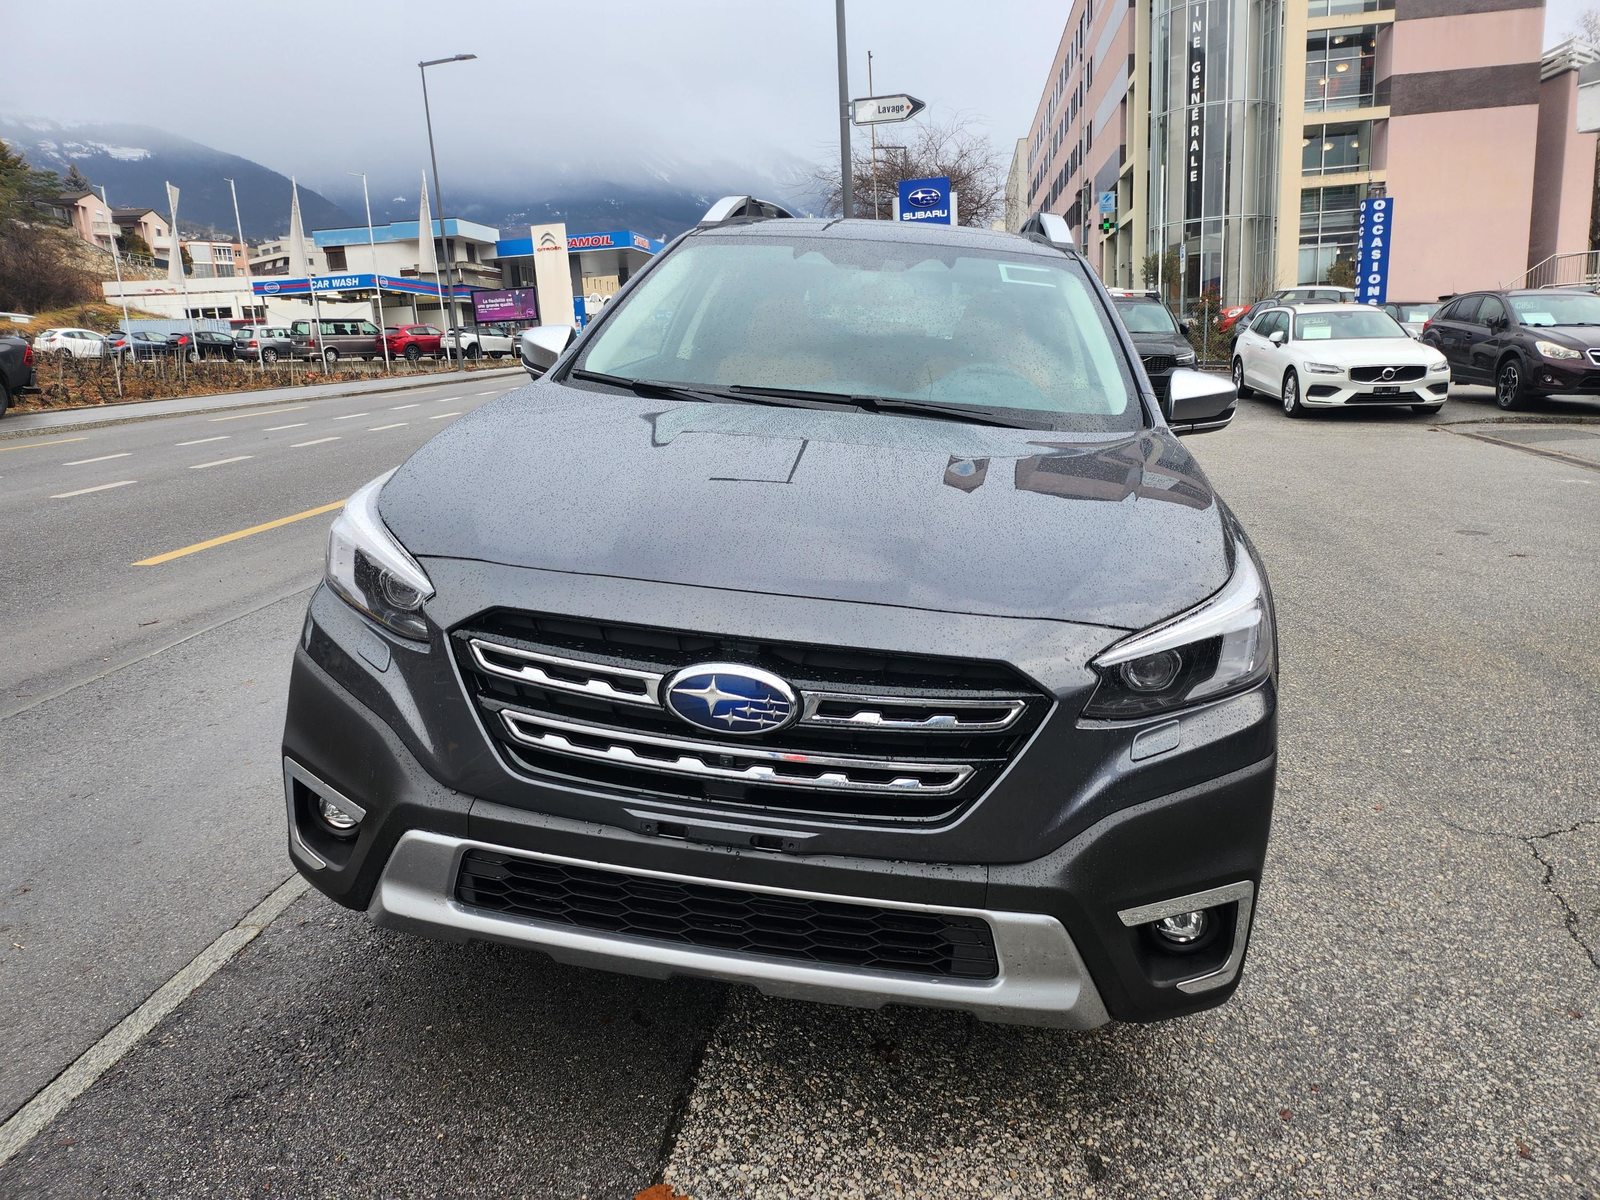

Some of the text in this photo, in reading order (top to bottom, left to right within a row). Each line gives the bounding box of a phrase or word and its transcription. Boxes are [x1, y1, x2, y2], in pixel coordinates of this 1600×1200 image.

[878, 104, 905, 114] Lavage
[1190, 61, 1201, 182] GÉNÉRALE
[902, 209, 948, 221] SUBARU
[311, 277, 359, 289] CAR WASH
